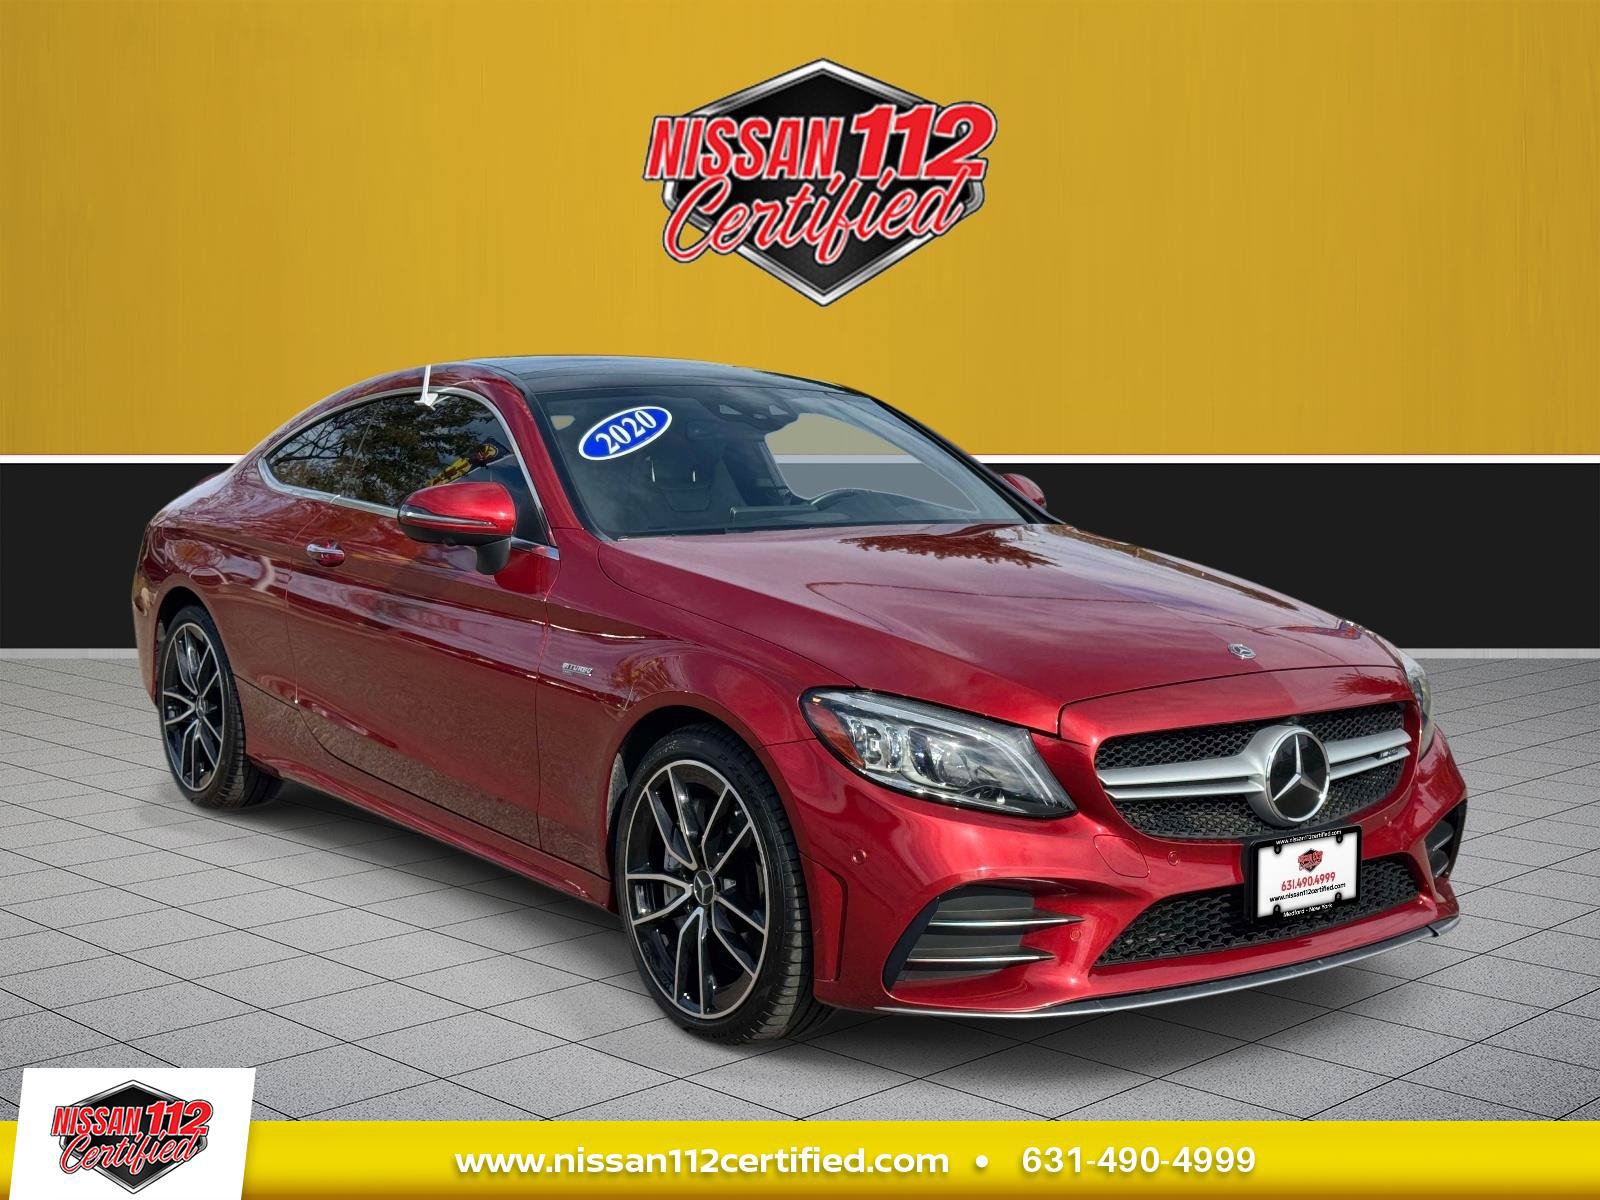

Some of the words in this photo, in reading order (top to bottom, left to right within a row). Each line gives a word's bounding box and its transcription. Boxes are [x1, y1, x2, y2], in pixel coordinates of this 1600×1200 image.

[595, 410, 657, 454] 2020
[1280, 871, 1336, 891] 631.490.4999
[1269, 883, 1346, 902] www.nissan112certified.com
